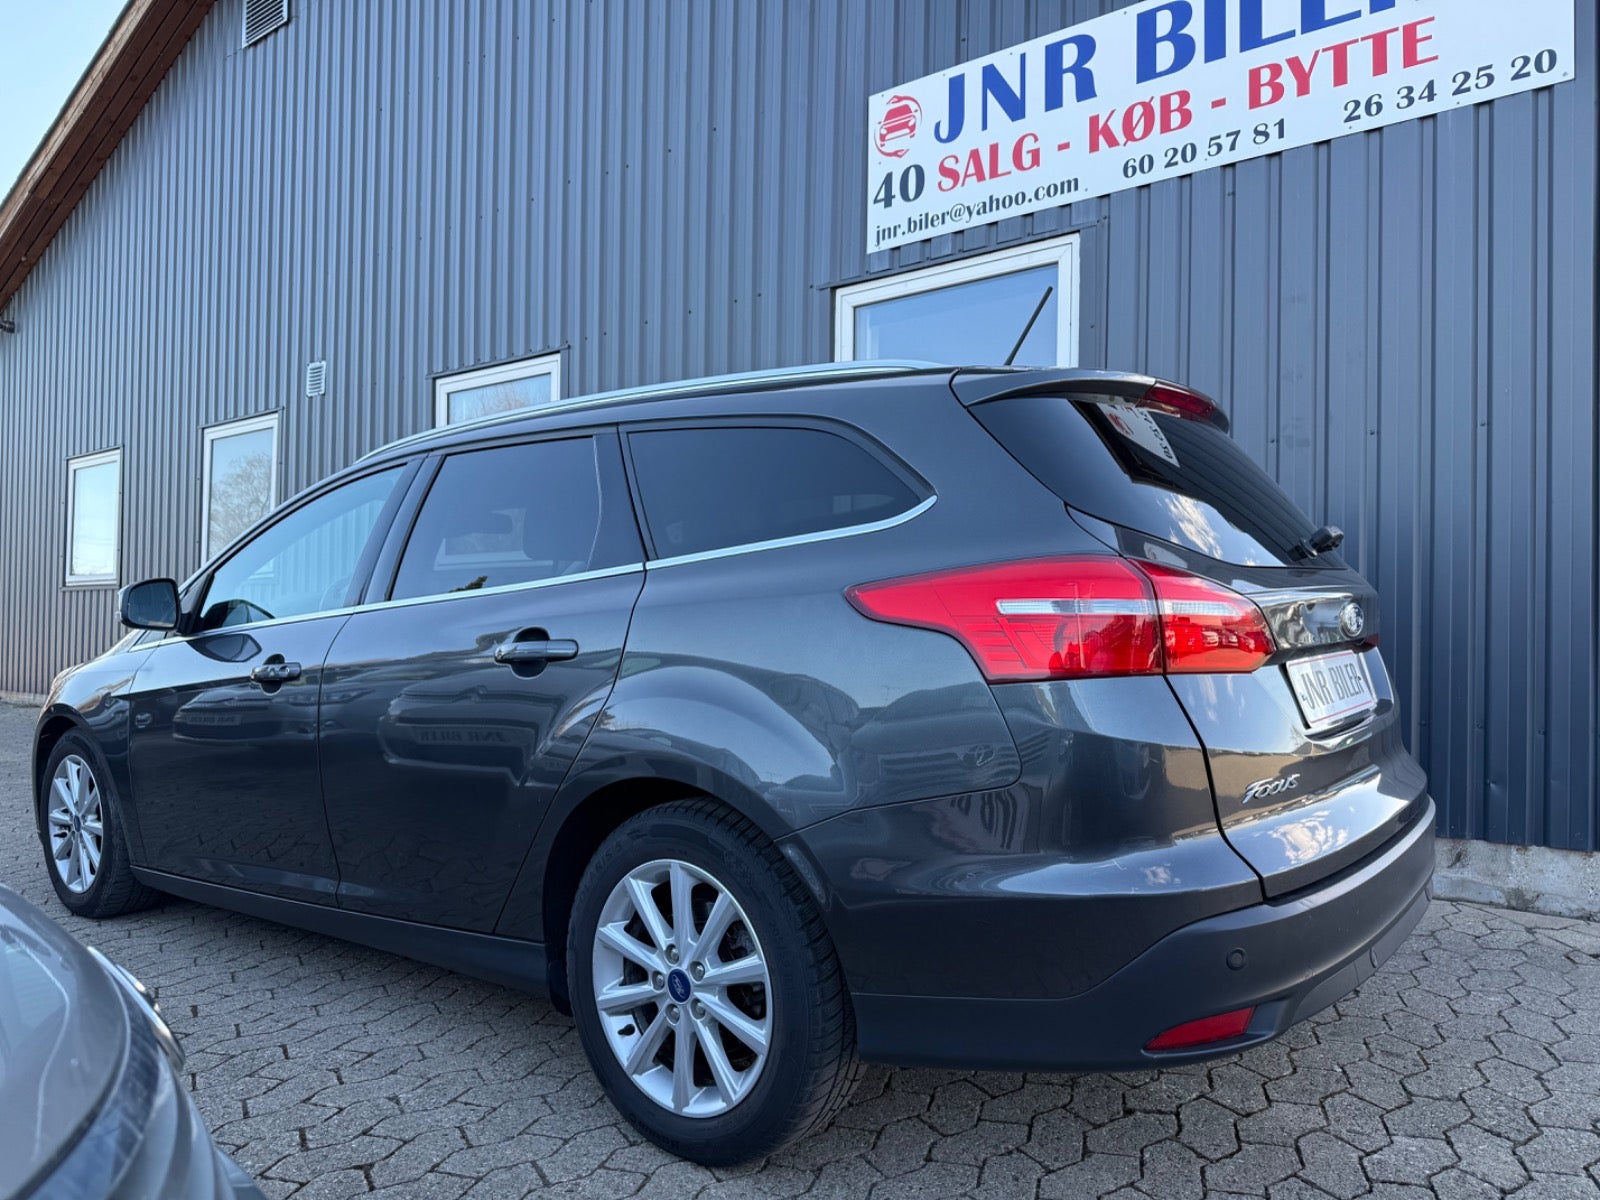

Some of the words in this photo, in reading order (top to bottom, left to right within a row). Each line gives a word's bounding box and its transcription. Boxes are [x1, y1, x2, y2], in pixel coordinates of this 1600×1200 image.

[934, 33, 1098, 144] JNR
[1136, 0, 1396, 84] BIL
[937, 132, 1041, 192] SALG
[1089, 89, 1193, 154] KØB
[1248, 16, 1439, 110] BYTTE
[1343, 93, 1384, 123] 26
[1396, 79, 1437, 109] 34
[1452, 64, 1496, 97] 25
[1510, 48, 1558, 81] 20
[1122, 154, 1154, 178] 60
[1164, 142, 1197, 169] 20
[1207, 129, 1242, 157] 57
[1253, 118, 1285, 145] 81
[873, 164, 926, 209] 40
[875, 177, 1079, 247] jnr.biler@yahoo.com
[1300, 670, 1335, 710] JNR
[1328, 662, 1365, 701] BILER
[1242, 773, 1301, 804] Focus
